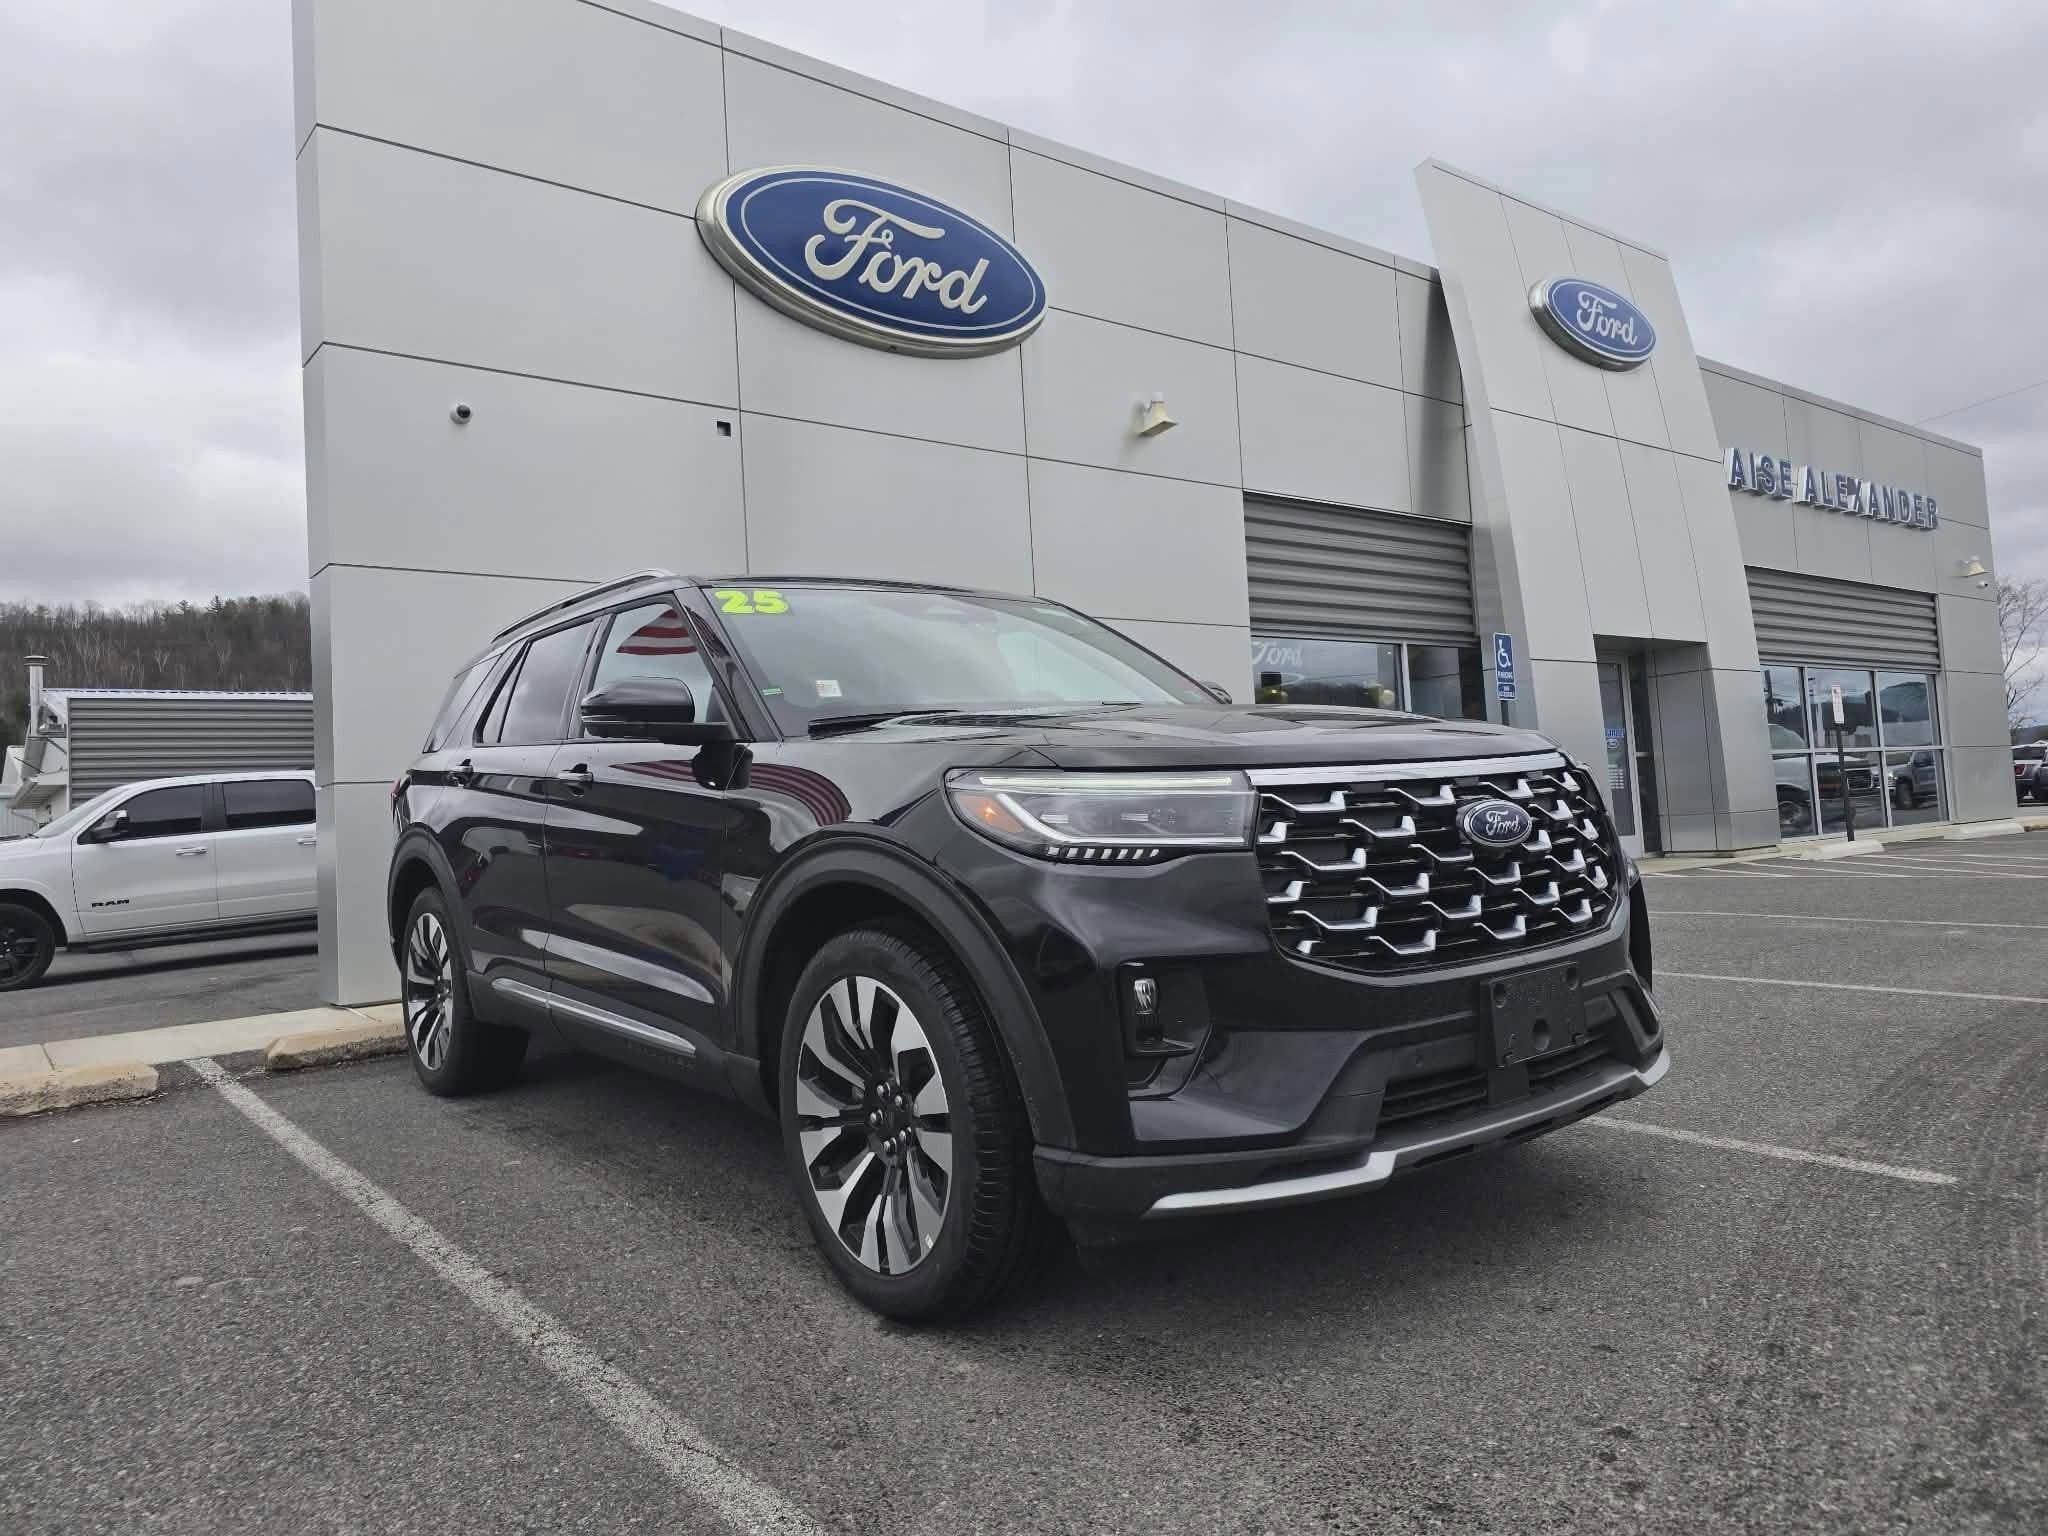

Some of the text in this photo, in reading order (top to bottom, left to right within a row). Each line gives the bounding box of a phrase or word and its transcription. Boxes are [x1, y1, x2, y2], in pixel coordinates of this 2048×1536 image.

[805, 199, 989, 314] Ford
[1576, 291, 1638, 345] Ford
[1799, 465, 1938, 528] ALEXANDER
[715, 590, 789, 615] 25
[1486, 810, 1521, 836] Ford
[91, 899, 130, 908] RAM
